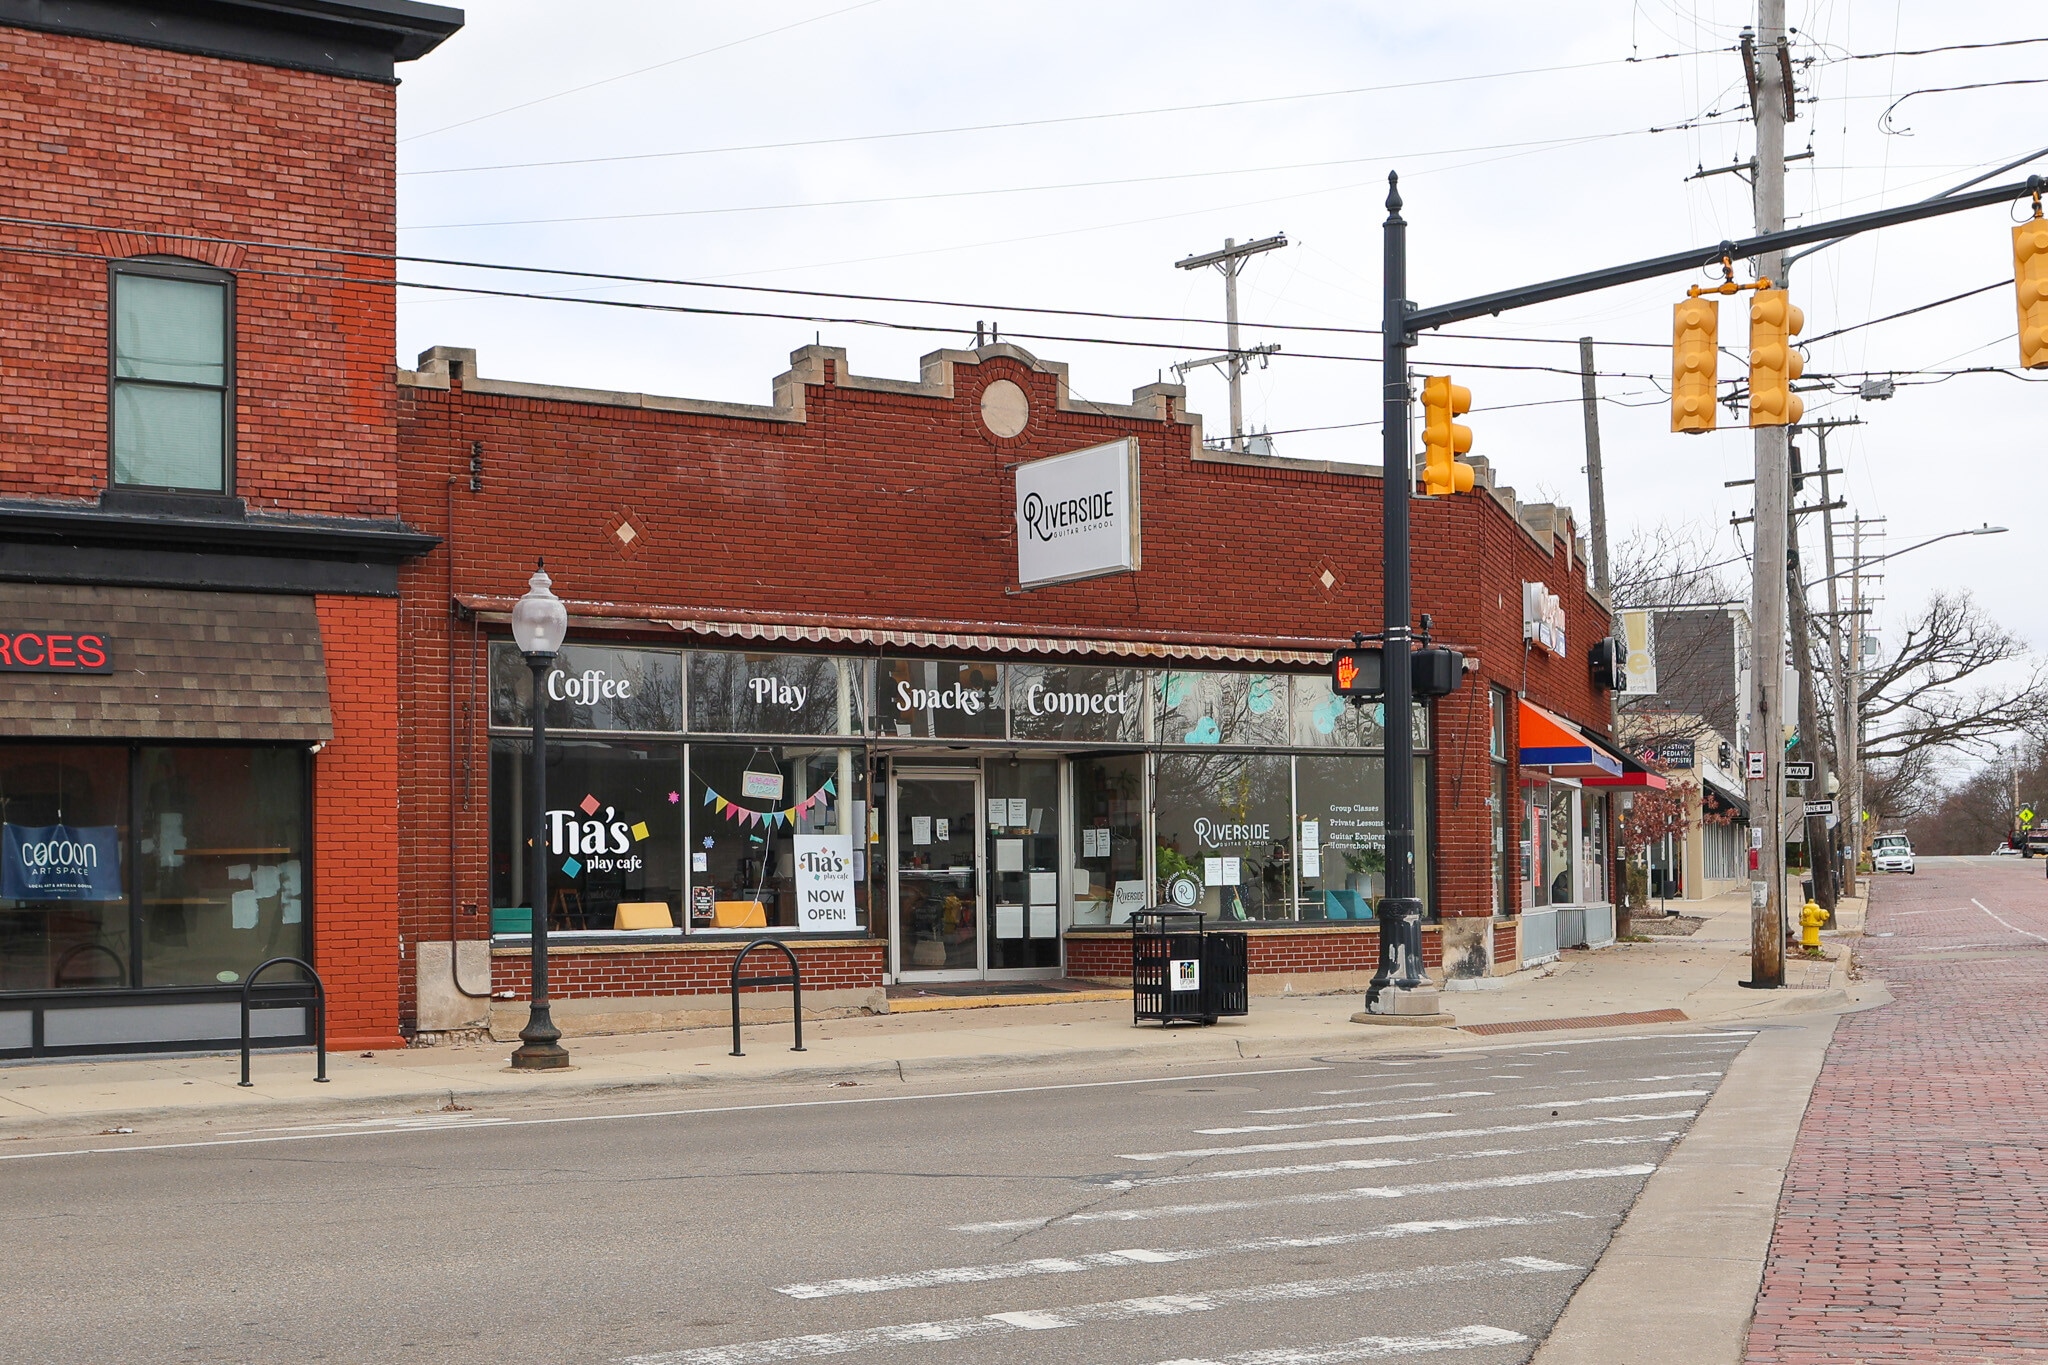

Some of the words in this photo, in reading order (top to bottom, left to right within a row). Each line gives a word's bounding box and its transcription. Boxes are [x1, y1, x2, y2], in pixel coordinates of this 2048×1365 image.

[1023, 491, 1114, 541] RIVERSIDE
[1053, 528, 1080, 539] GUITAR
[1083, 520, 1114, 533] SCHOOL
[547, 669, 631, 706] Coffee
[748, 676, 807, 712] Play
[896, 680, 980, 716] Snacks
[1027, 683, 1128, 716] Connect
[1790, 767, 1807, 775] WAY
[1330, 804, 1352, 814] Group
[1353, 804, 1379, 812] Classes
[545, 806, 630, 855] Tia's
[1330, 818, 1355, 827] Private
[1356, 819, 1385, 827] Lessons
[1193, 817, 1270, 849] RIVERSIDE
[1330, 832, 1354, 840] Guitar
[586, 855, 615, 873] play
[616, 855, 642, 873] cafe
[800, 850, 843, 872] Tia's
[31, 867, 52, 876] ART
[55, 866, 89, 877] SPACE
[807, 890, 845, 903] NOW
[1116, 887, 1144, 904] RIVERSIDE
[807, 908, 847, 920] OPEN!
